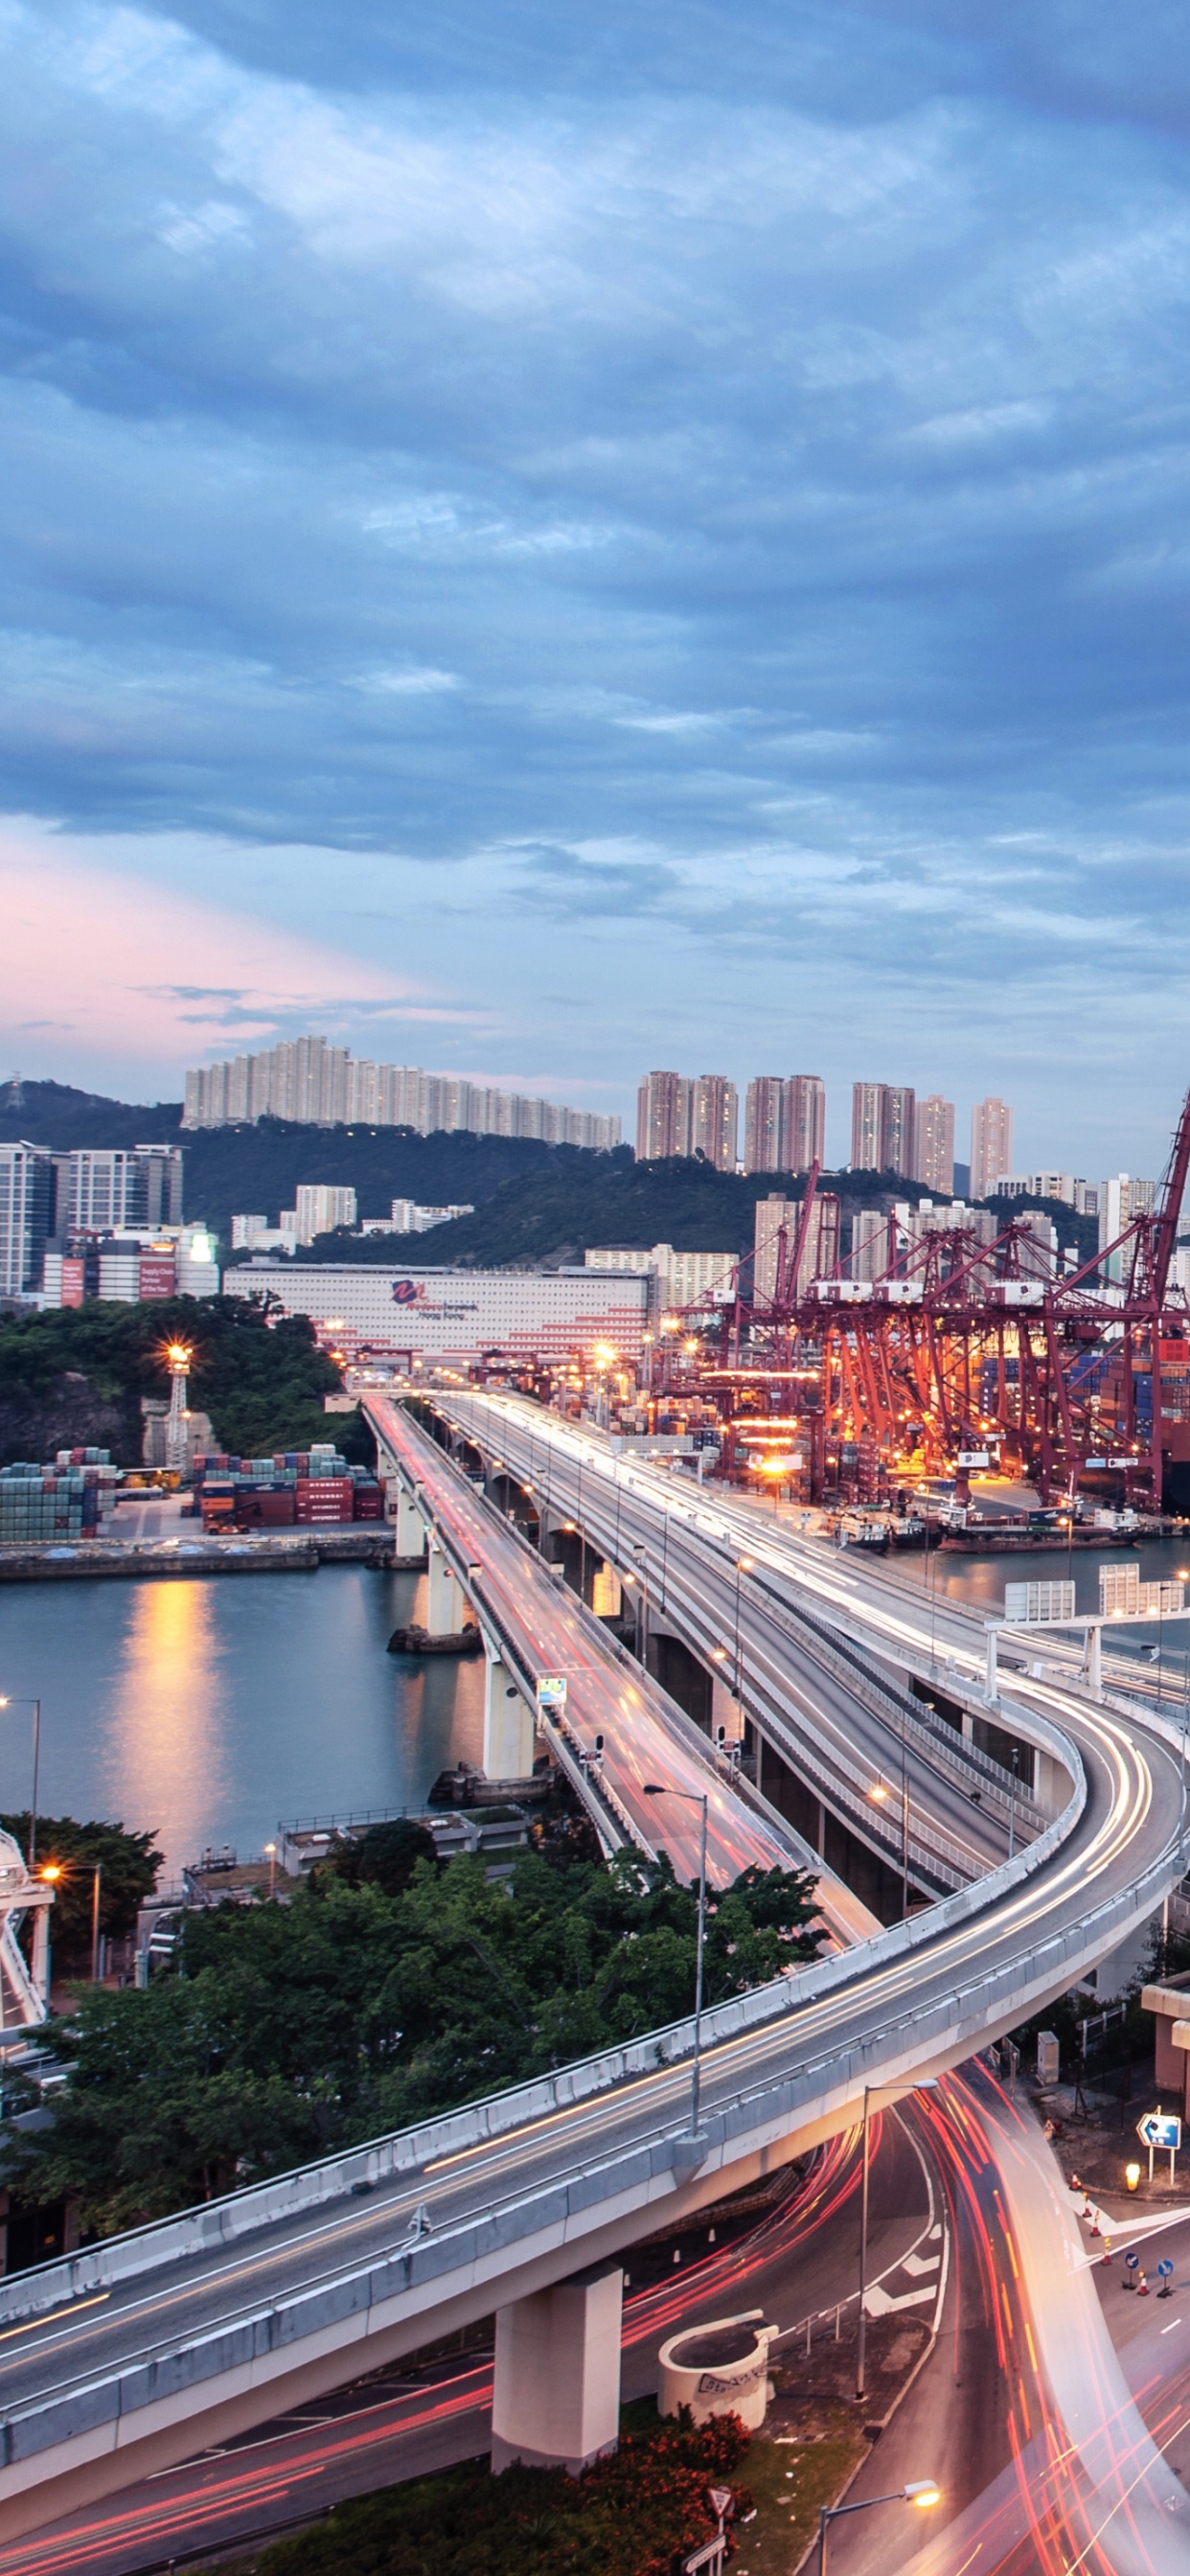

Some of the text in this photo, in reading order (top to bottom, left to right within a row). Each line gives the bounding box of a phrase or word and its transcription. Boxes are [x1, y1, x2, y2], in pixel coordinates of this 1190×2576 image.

[407, 1302, 443, 1311] Modern
[419, 1311, 465, 1321] Hong Kong
